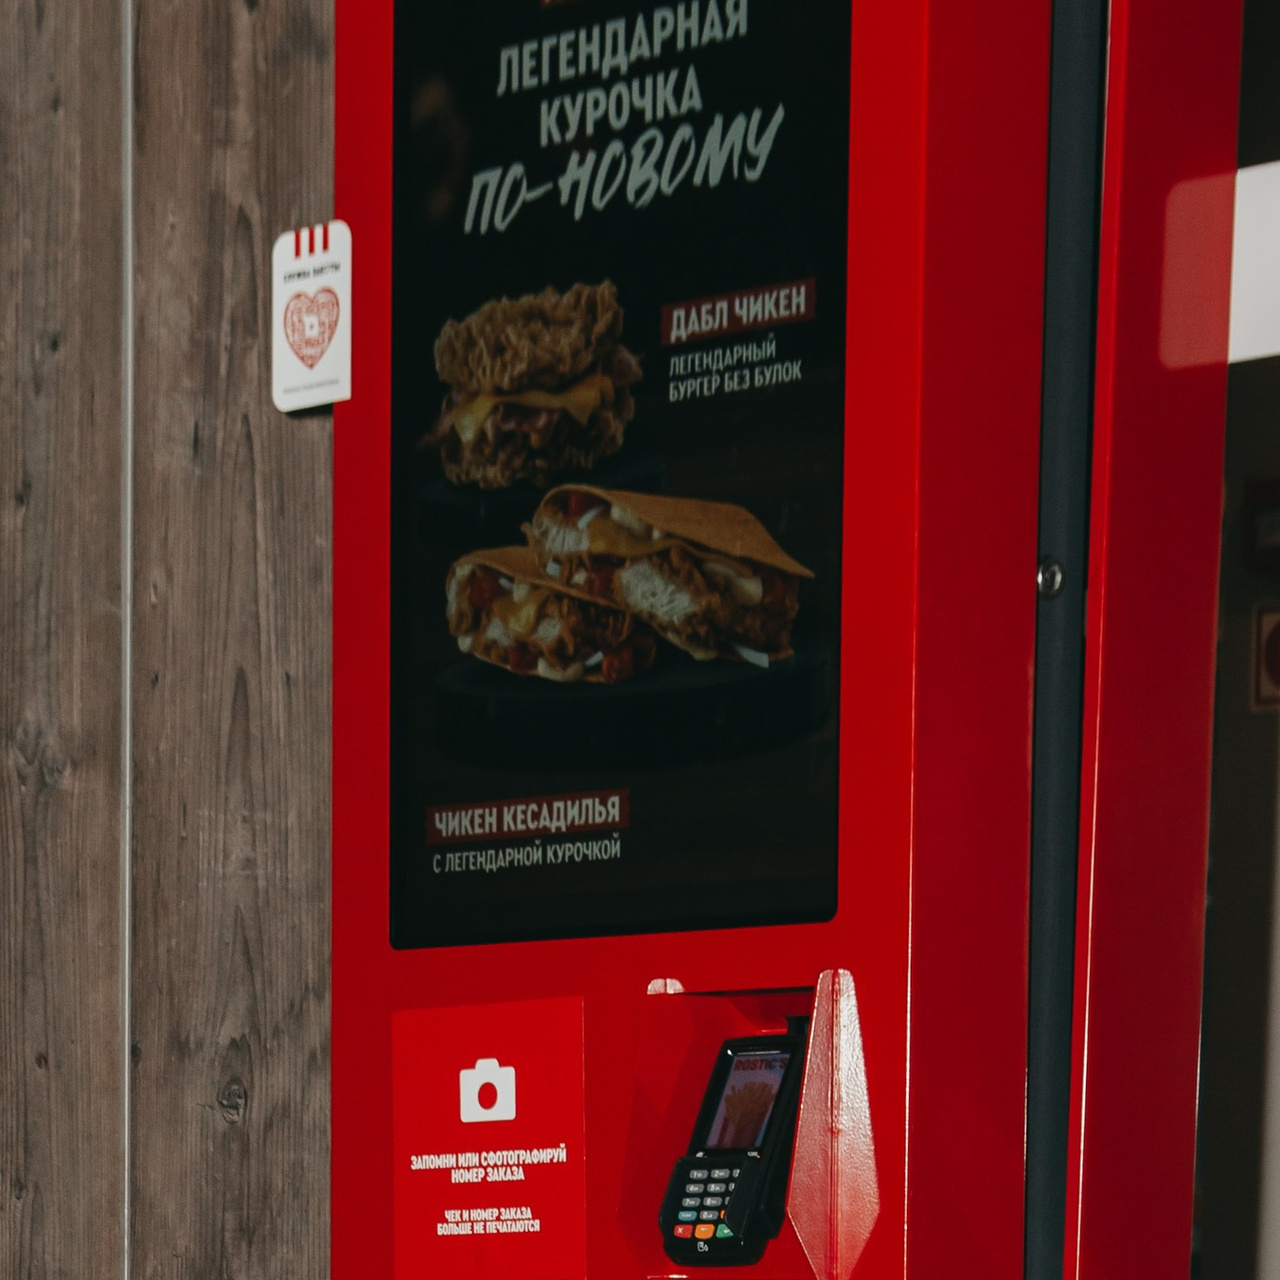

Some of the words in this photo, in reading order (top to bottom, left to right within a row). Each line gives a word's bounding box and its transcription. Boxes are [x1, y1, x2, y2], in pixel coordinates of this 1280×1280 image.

[496, 0, 748, 97] ЛЕГЕНДАРНАЯ
[540, 64, 703, 148] КУРОЧКА
[464, 102, 785, 235] ПО-НОВОМУ
[670, 300, 729, 344] ДАБЛ
[734, 284, 807, 325] ЧИКЕН
[669, 331, 776, 377] ЛЕГЕНДАРНЫЙ
[669, 375, 720, 402] БУРГЕР
[724, 368, 750, 393] БЕЗ
[754, 360, 802, 388] БУЛОК
[435, 807, 498, 837] ЧИКЕН
[503, 795, 620, 833] КЕСАДИЛЬЯ
[433, 854, 442, 873] С
[445, 839, 542, 873] ЛЕГЕНДАРНОЙ
[547, 832, 621, 864] КУРОЧКОЙ
[411, 1153, 457, 1170] ЗАПОМНИ
[458, 1152, 479, 1167] ИЛИ
[481, 1143, 567, 1167] СФОТОГРАФИРУЙ
[451, 1168, 485, 1183] НОМЕР
[486, 1166, 525, 1182] ЗАКАЗА
[437, 1222, 472, 1236] БОЛЬШЕ
[474, 1221, 485, 1234] НЕ
[486, 1219, 540, 1233] ПЕЧАТАЮТСЯ
[445, 1209, 462, 1222] ЧЕК
[463, 1209, 469, 1221] И
[470, 1208, 498, 1221] НОМЕР
[500, 1207, 532, 1220] ЗАКАЗА
